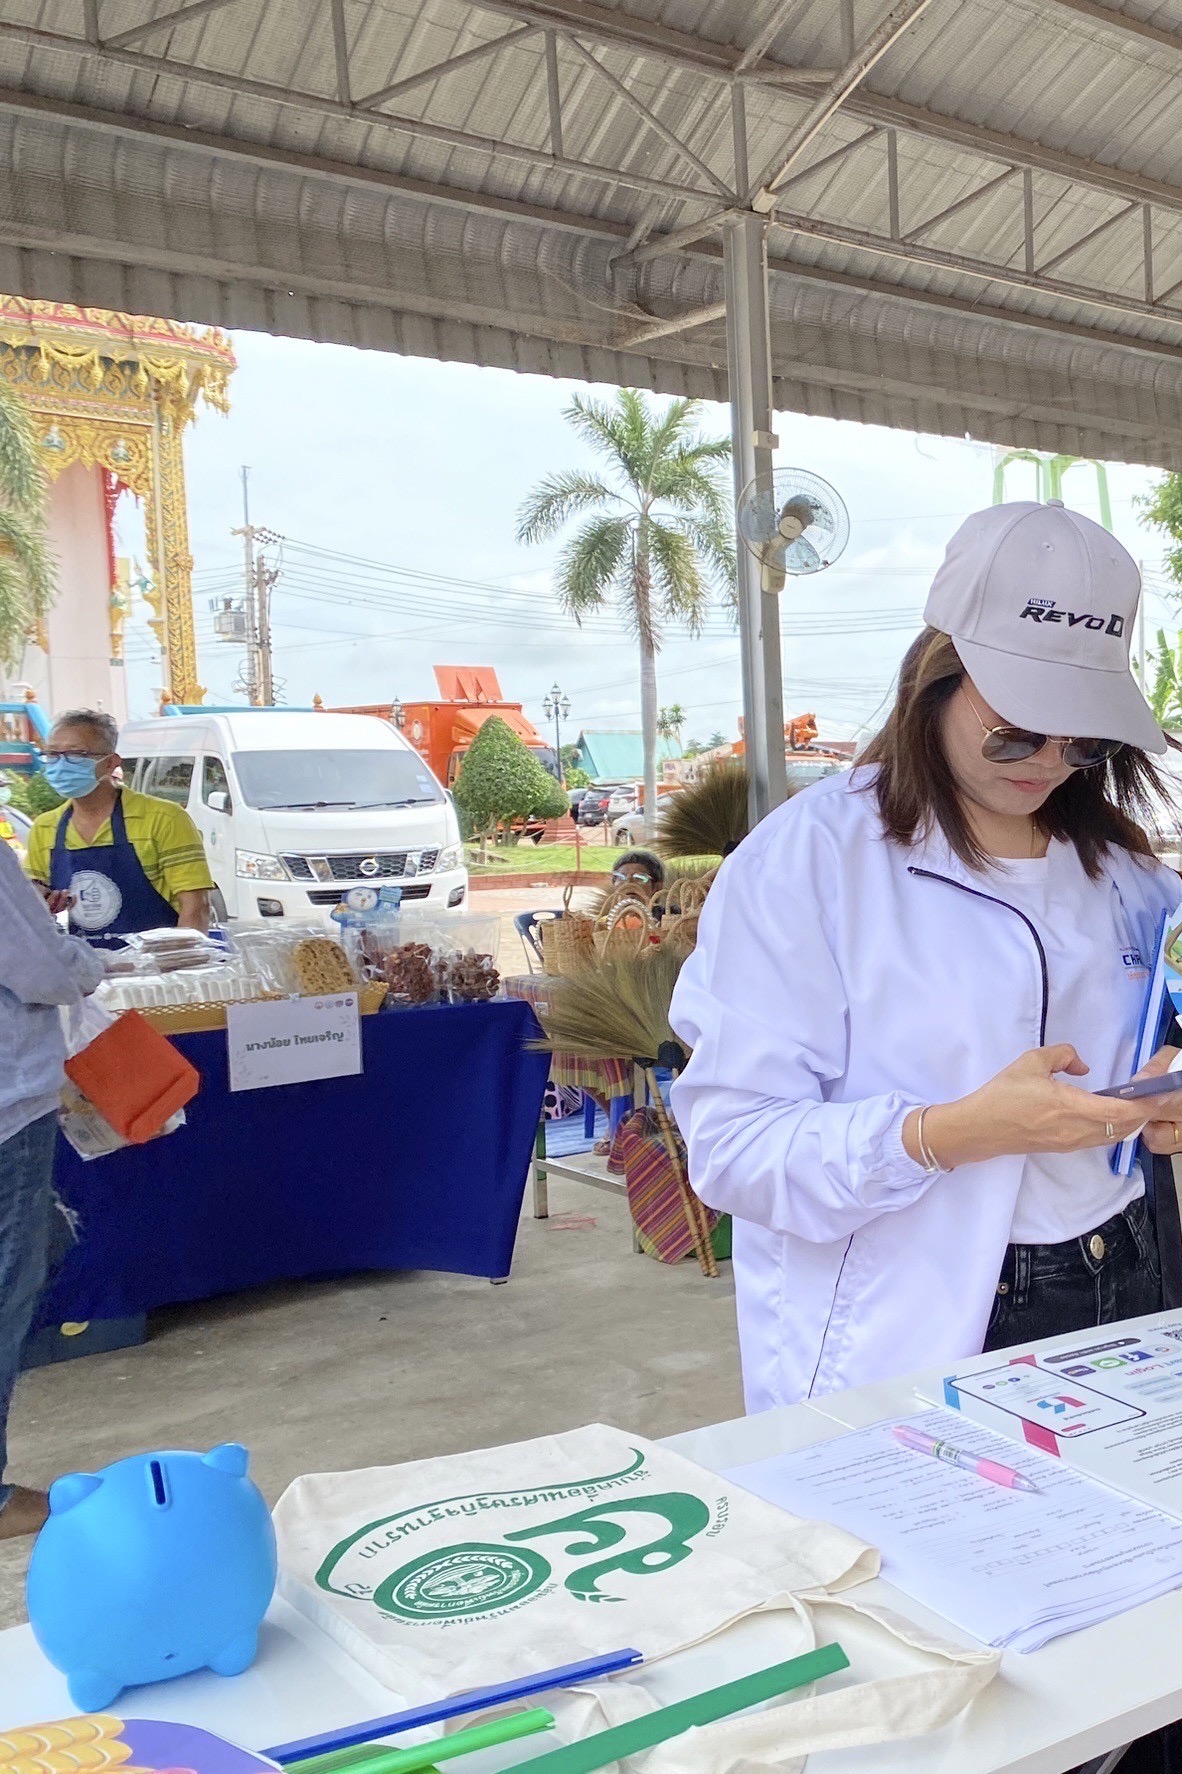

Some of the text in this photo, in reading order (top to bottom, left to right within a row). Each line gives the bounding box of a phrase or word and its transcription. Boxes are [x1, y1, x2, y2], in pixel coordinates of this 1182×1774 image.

[1019, 606, 1105, 630] REVO
[245, 1037, 291, 1052] นางน้อย
[359, 1470, 652, 1559] ขับเคลื่อนเศรษฐกิจฐานราก
[706, 1497, 729, 1537] ครบรอบ
